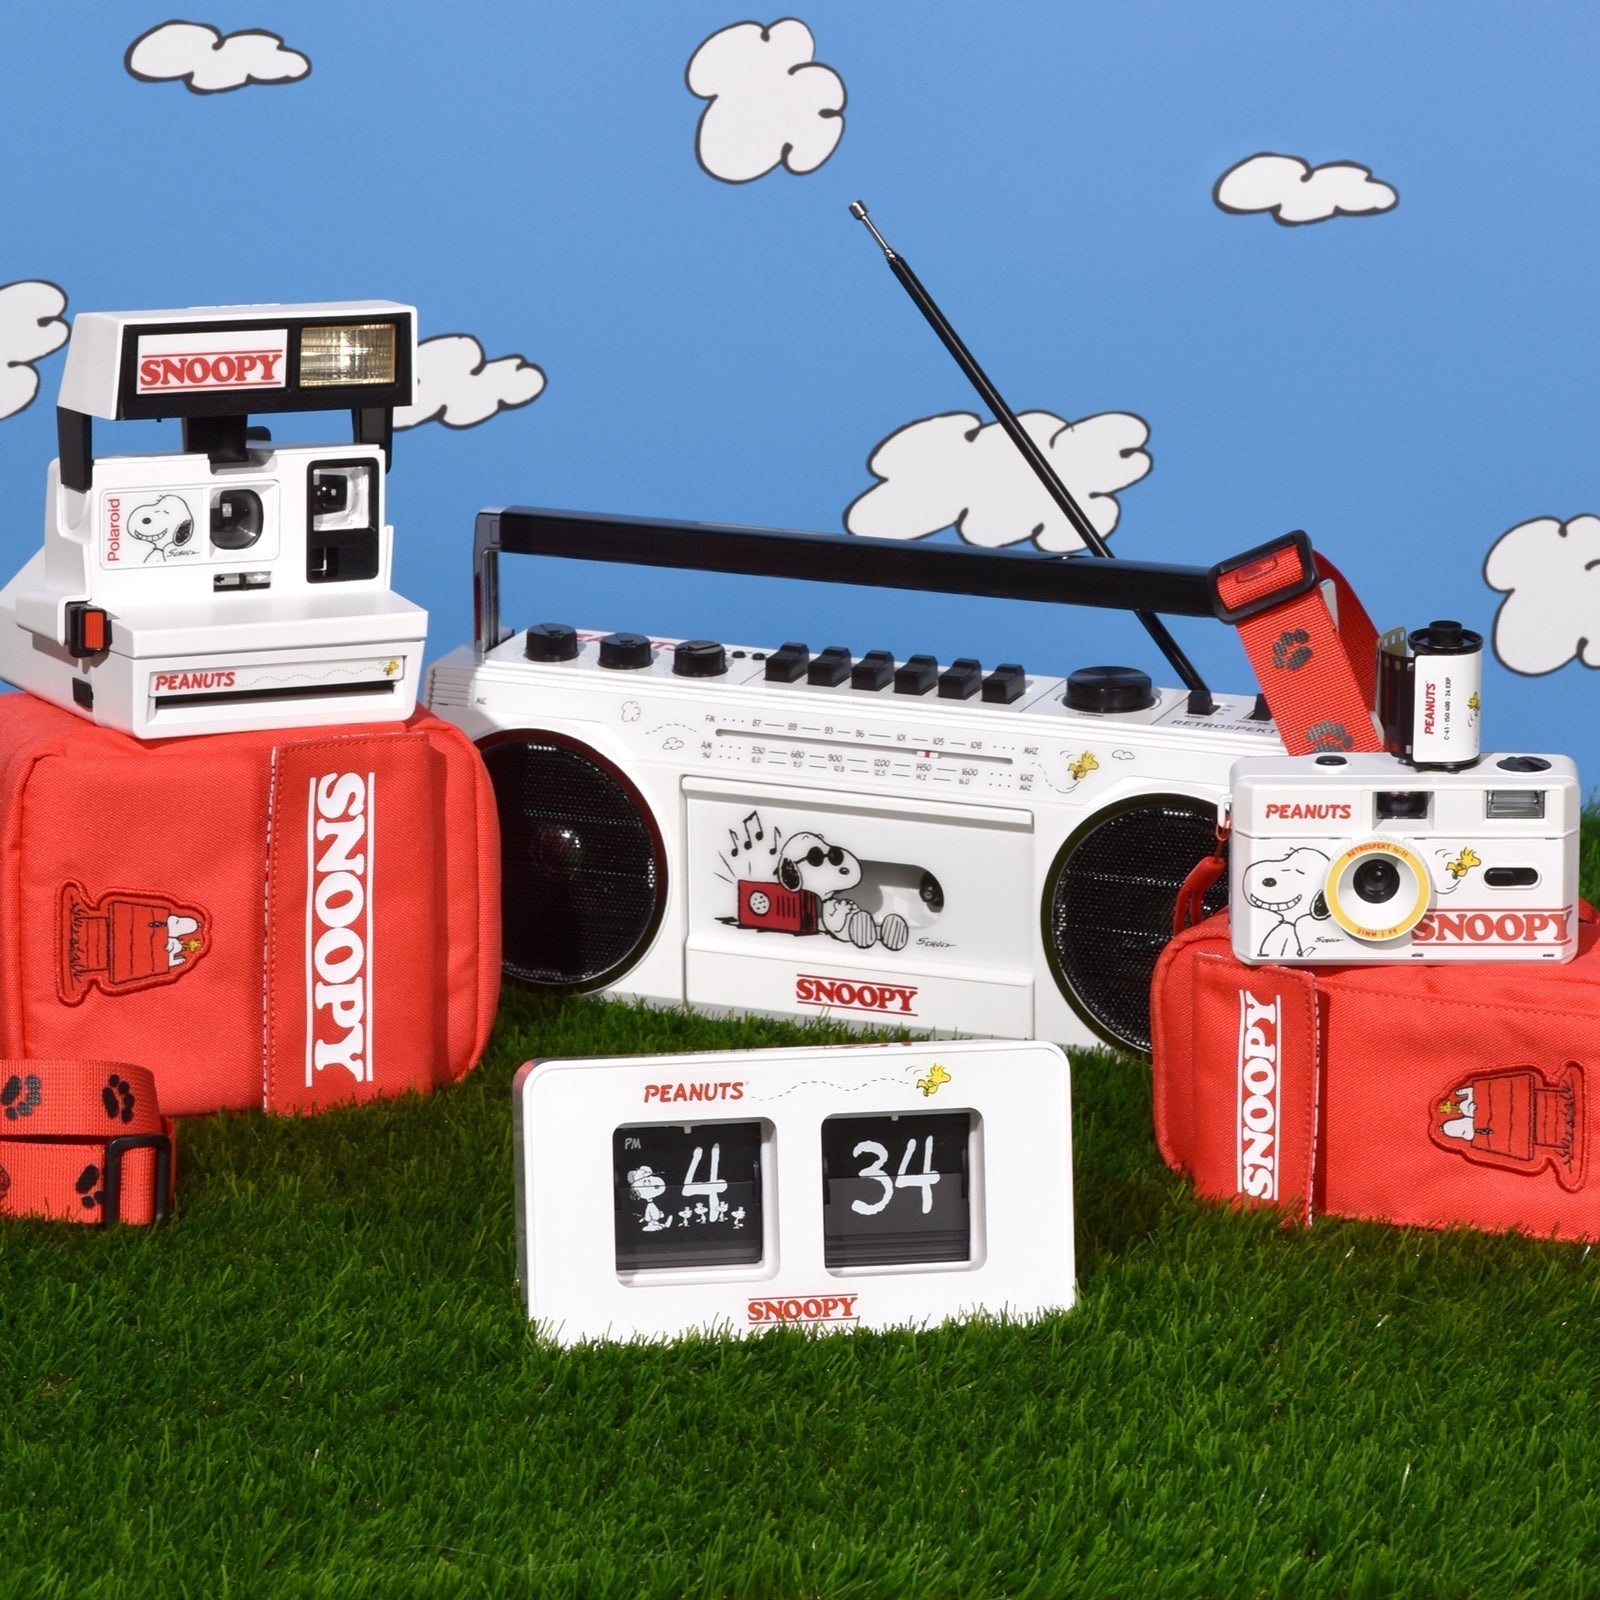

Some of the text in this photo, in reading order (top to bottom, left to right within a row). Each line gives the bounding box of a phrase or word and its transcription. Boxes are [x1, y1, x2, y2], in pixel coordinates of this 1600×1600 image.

[140, 354, 282, 385] SNOOPY
[107, 498, 121, 562] Polaroid
[155, 672, 235, 691] PEANUTS
[1424, 682, 1436, 735] PEANUTS
[705, 715, 715, 723] FM
[787, 723, 798, 731] 89
[824, 726, 834, 735] 93
[855, 729, 865, 738] 96
[897, 734, 906, 742] 101
[933, 737, 945, 746] 105
[970, 741, 983, 750] 108
[1171, 719, 1279, 734] RETROSPEKT
[701, 741, 712, 749] AM
[752, 746, 766, 755] 530
[790, 750, 805, 759] 680
[828, 754, 843, 763] 900
[874, 759, 891, 768] 1200
[961, 767, 978, 777] 1600
[1265, 804, 1351, 819] PEANUTS
[315, 772, 366, 1082] SNOOPY
[1411, 910, 1572, 941] SNOOPY
[796, 978, 918, 1012] SNOOPY
[643, 1081, 744, 1103] PEANUTS
[1242, 990, 1277, 1200] SNOOPY
[624, 1138, 642, 1150] PM
[681, 1142, 728, 1222] 4
[851, 1135, 941, 1214] 34
[747, 1297, 858, 1321] SNOOPY
